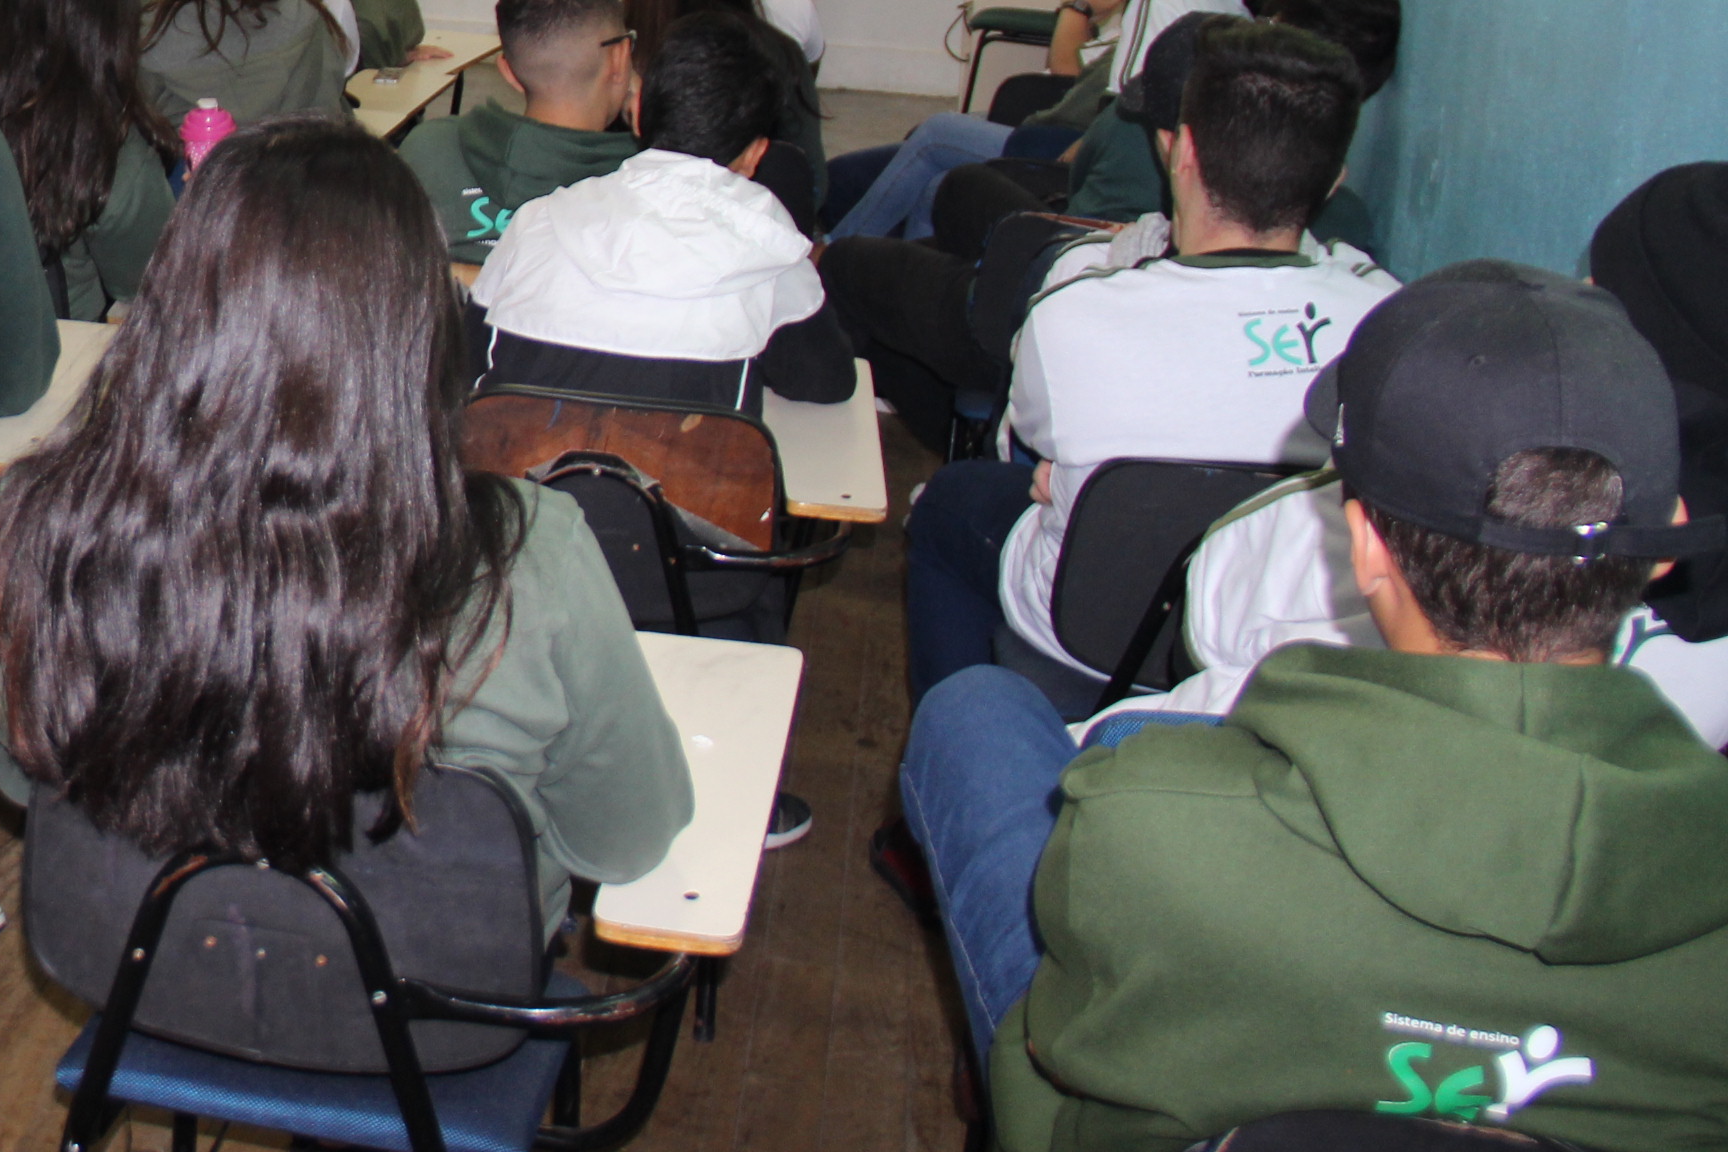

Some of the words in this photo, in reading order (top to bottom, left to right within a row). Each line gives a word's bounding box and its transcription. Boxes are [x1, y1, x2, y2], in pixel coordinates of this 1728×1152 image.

[1384, 1011, 1444, 1033] Sistema
[1446, 1023, 1467, 1038] de
[1469, 1028, 1521, 1047] ensino
